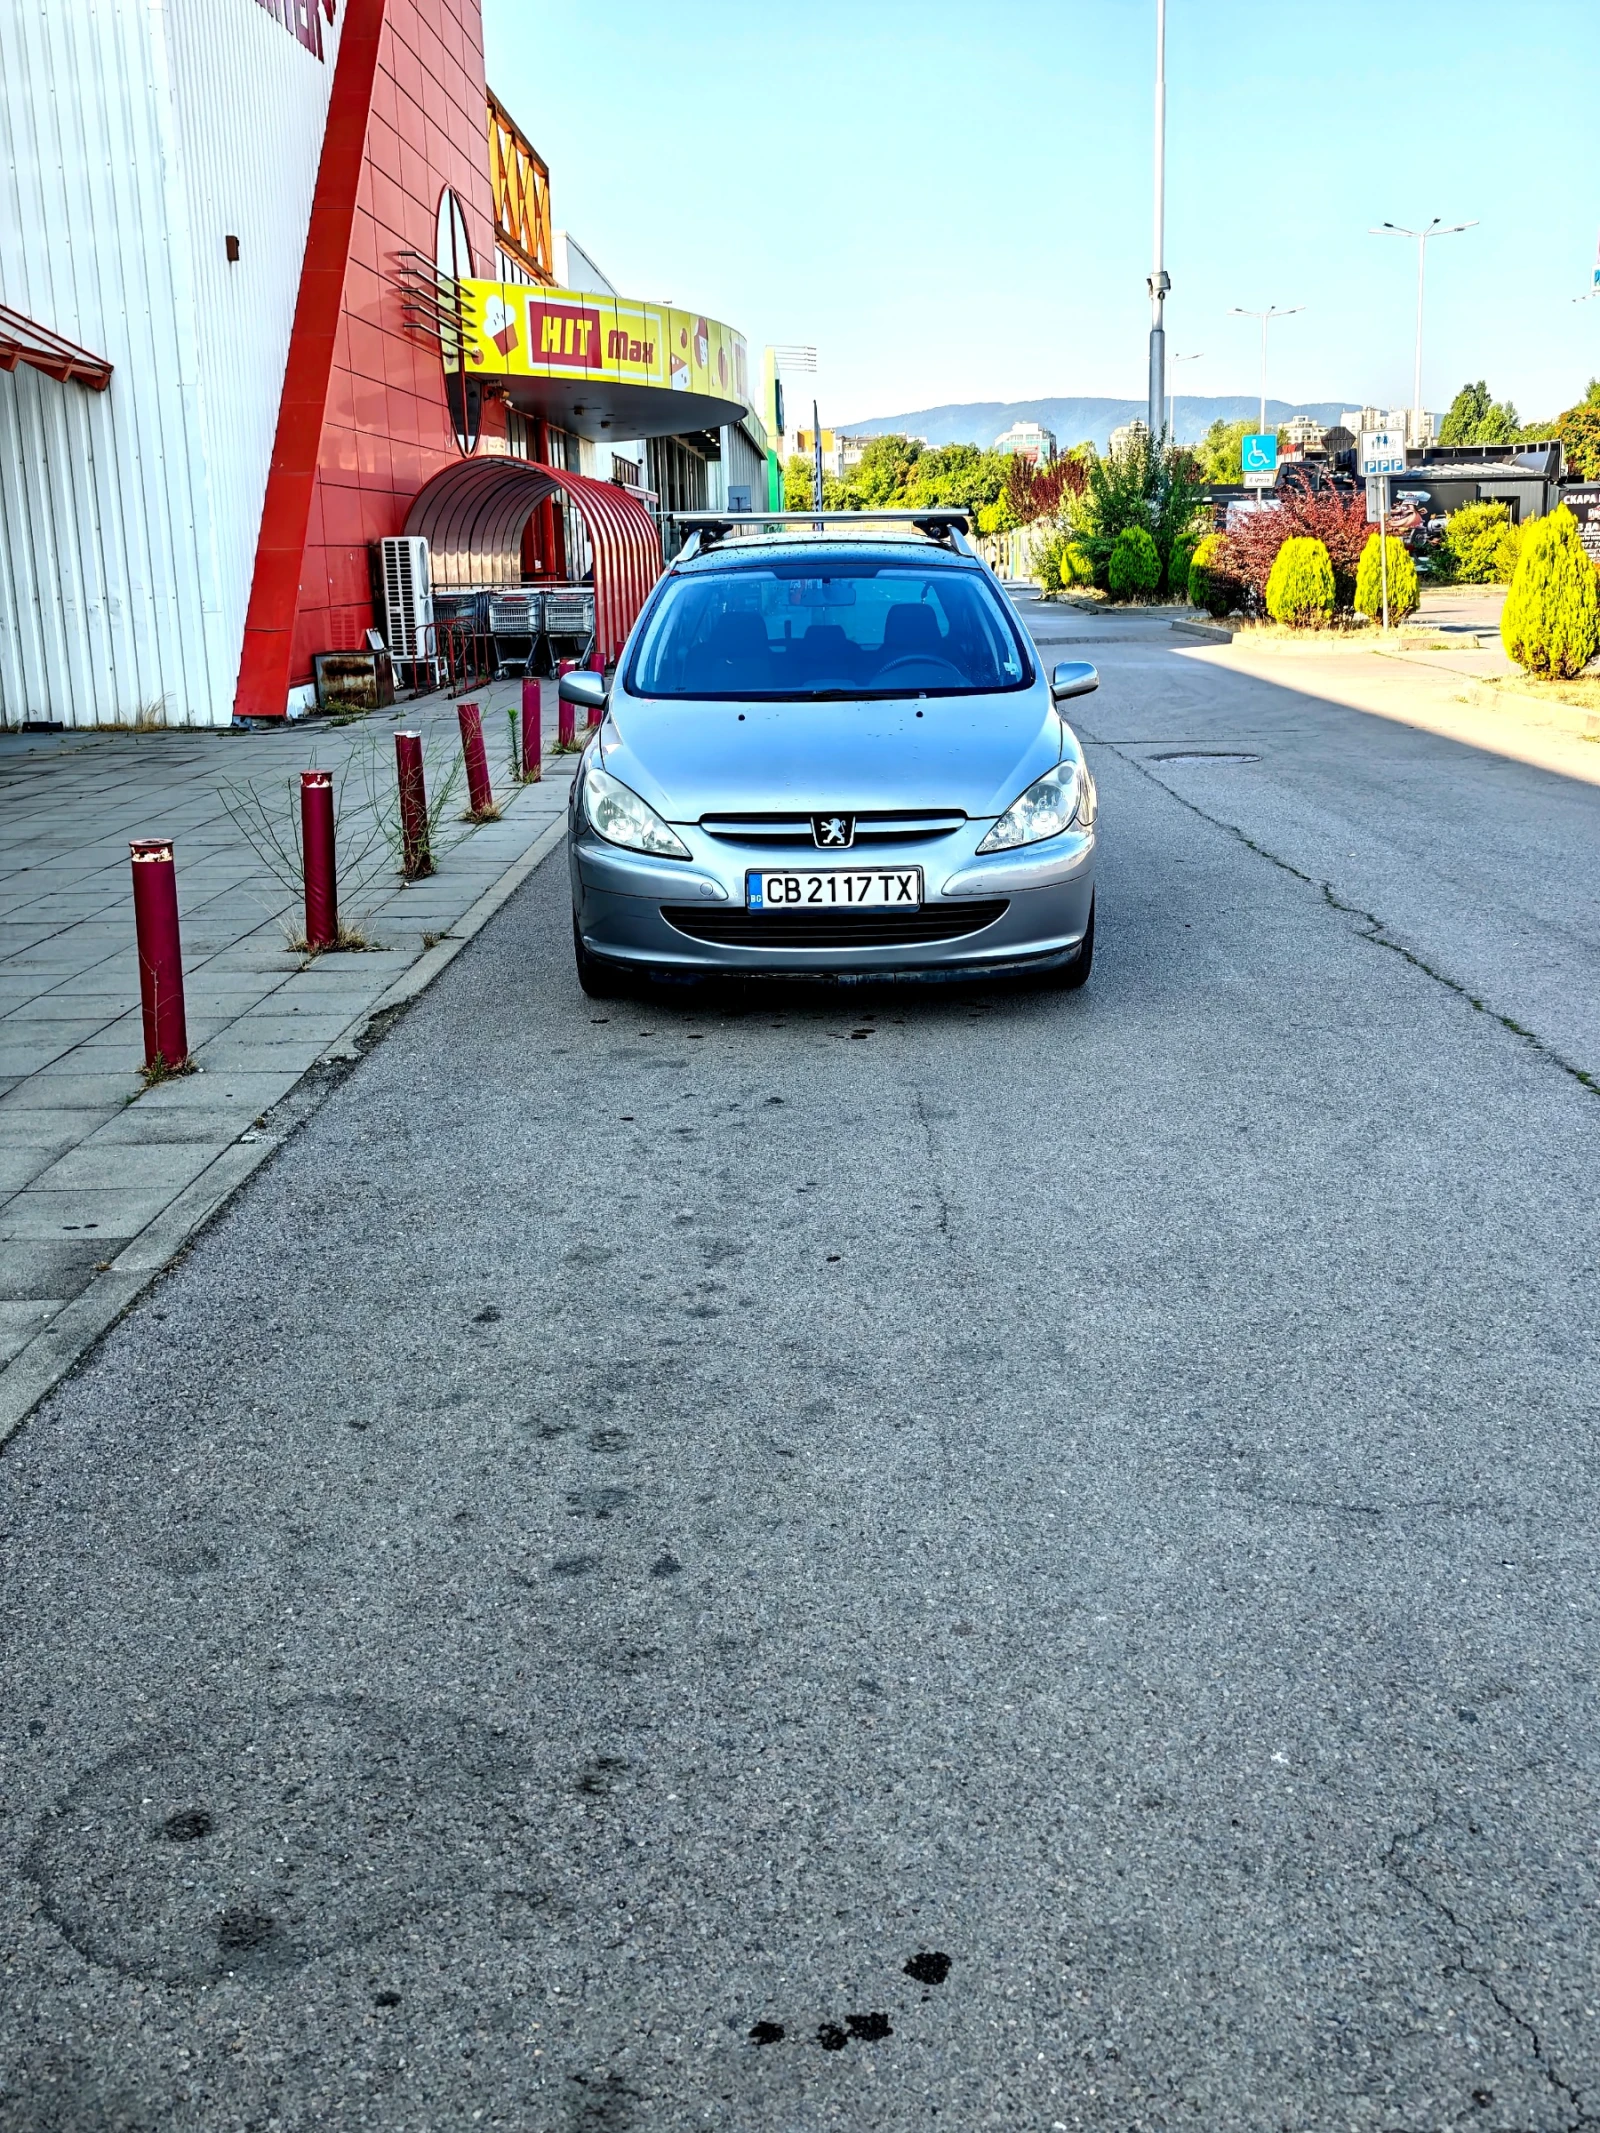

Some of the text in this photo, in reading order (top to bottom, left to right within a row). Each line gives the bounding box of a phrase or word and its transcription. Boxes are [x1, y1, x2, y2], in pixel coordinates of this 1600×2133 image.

[541, 315, 654, 364] HIT Max
[1368, 460, 1402, 473] P P P
[1563, 494, 1596, 505] СКАРА
[750, 894, 762, 903] BG
